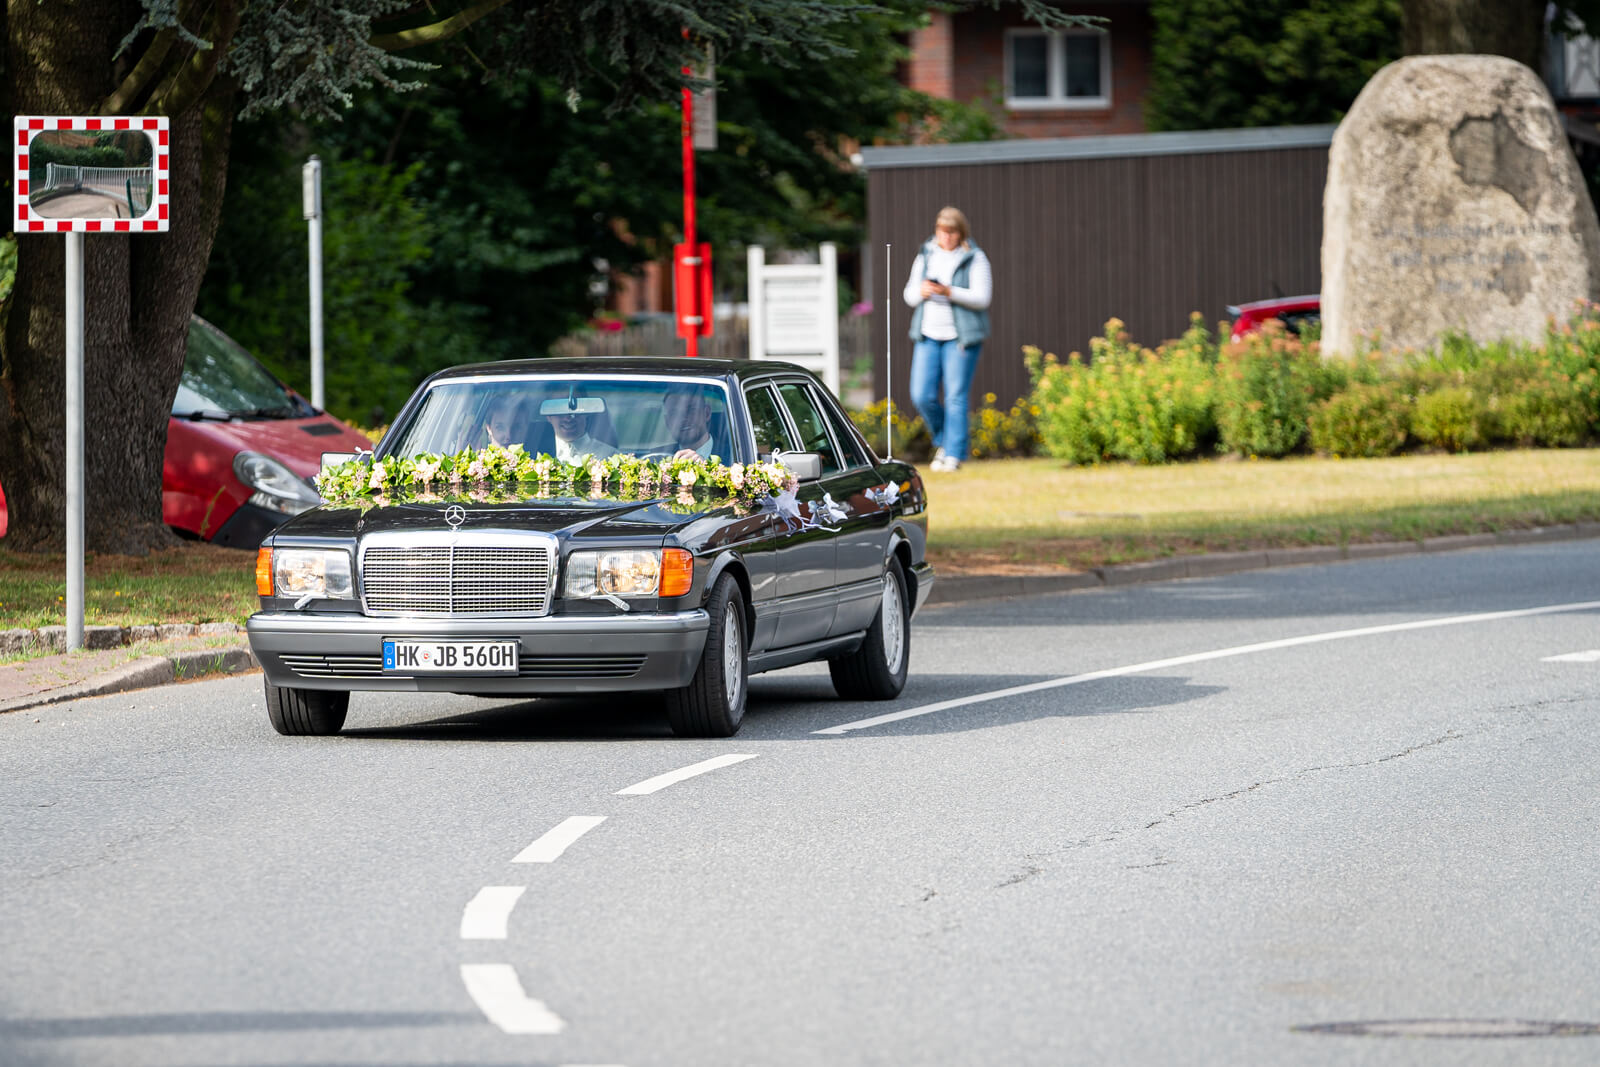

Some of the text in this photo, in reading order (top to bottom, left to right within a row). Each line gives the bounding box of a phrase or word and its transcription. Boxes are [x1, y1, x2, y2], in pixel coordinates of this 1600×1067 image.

[396, 645, 514, 667] HK JB 560H
